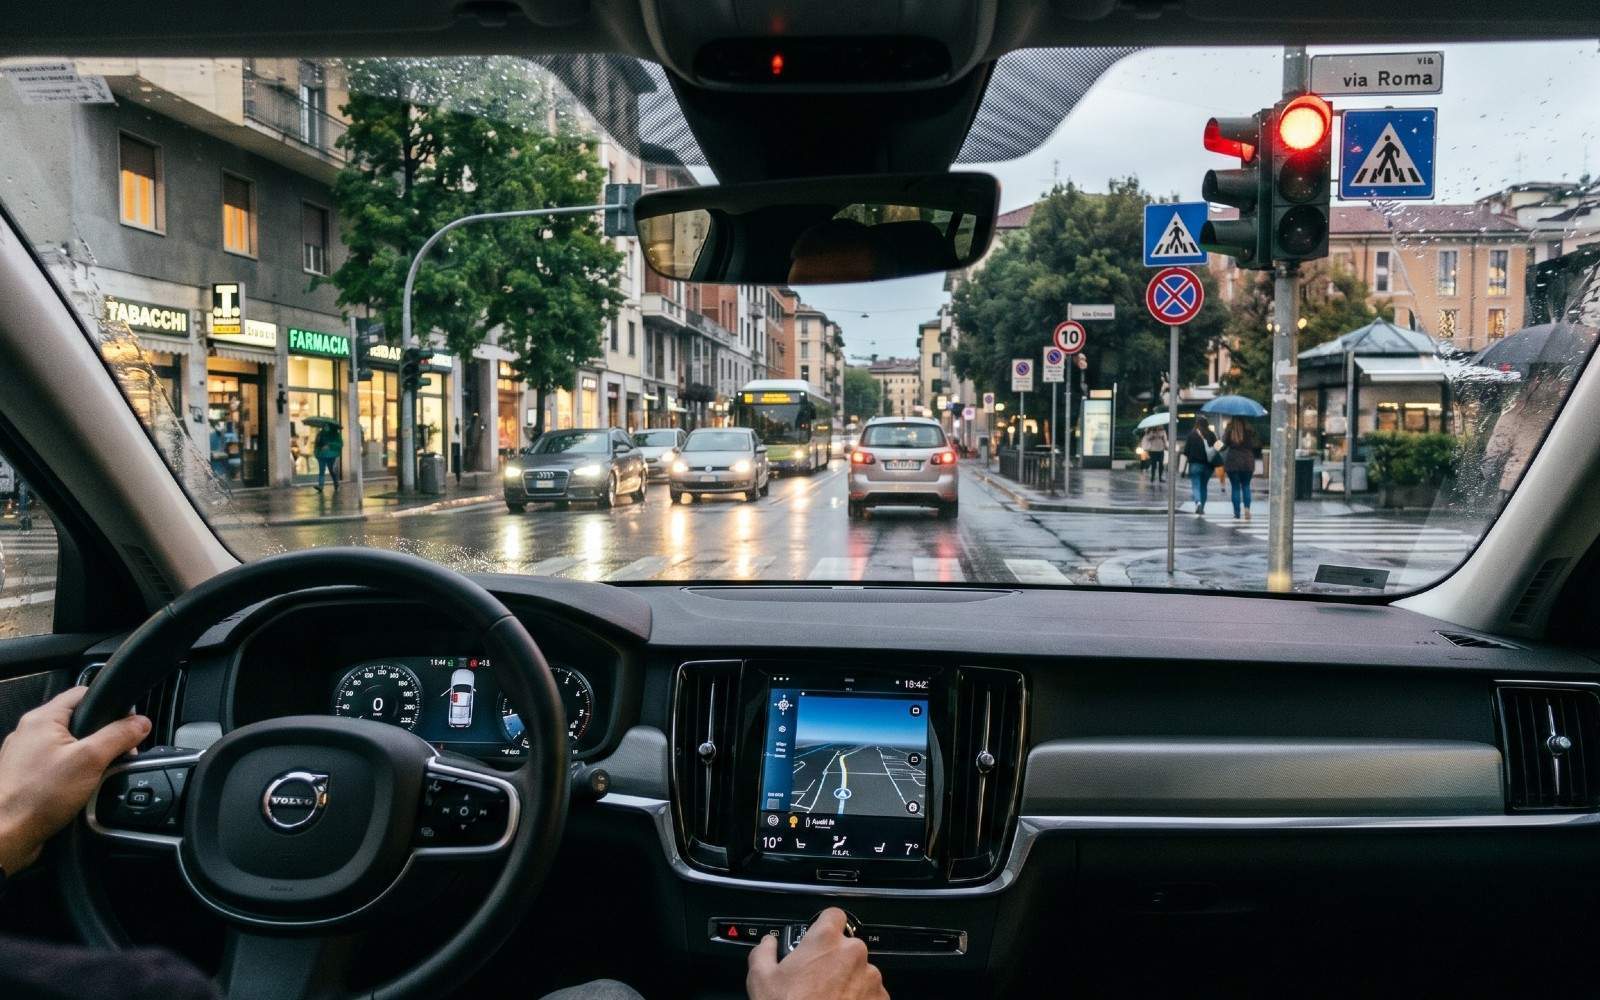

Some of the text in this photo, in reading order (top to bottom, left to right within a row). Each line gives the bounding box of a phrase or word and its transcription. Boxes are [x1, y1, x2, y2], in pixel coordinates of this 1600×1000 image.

[1343, 71, 1433, 87] via Roma
[215, 285, 237, 318] T
[105, 301, 187, 332] TABACCHI
[289, 330, 350, 355] FARMACIA
[1061, 330, 1079, 345] 10
[373, 697, 384, 711] 0
[272, 797, 313, 805] VOLVO
